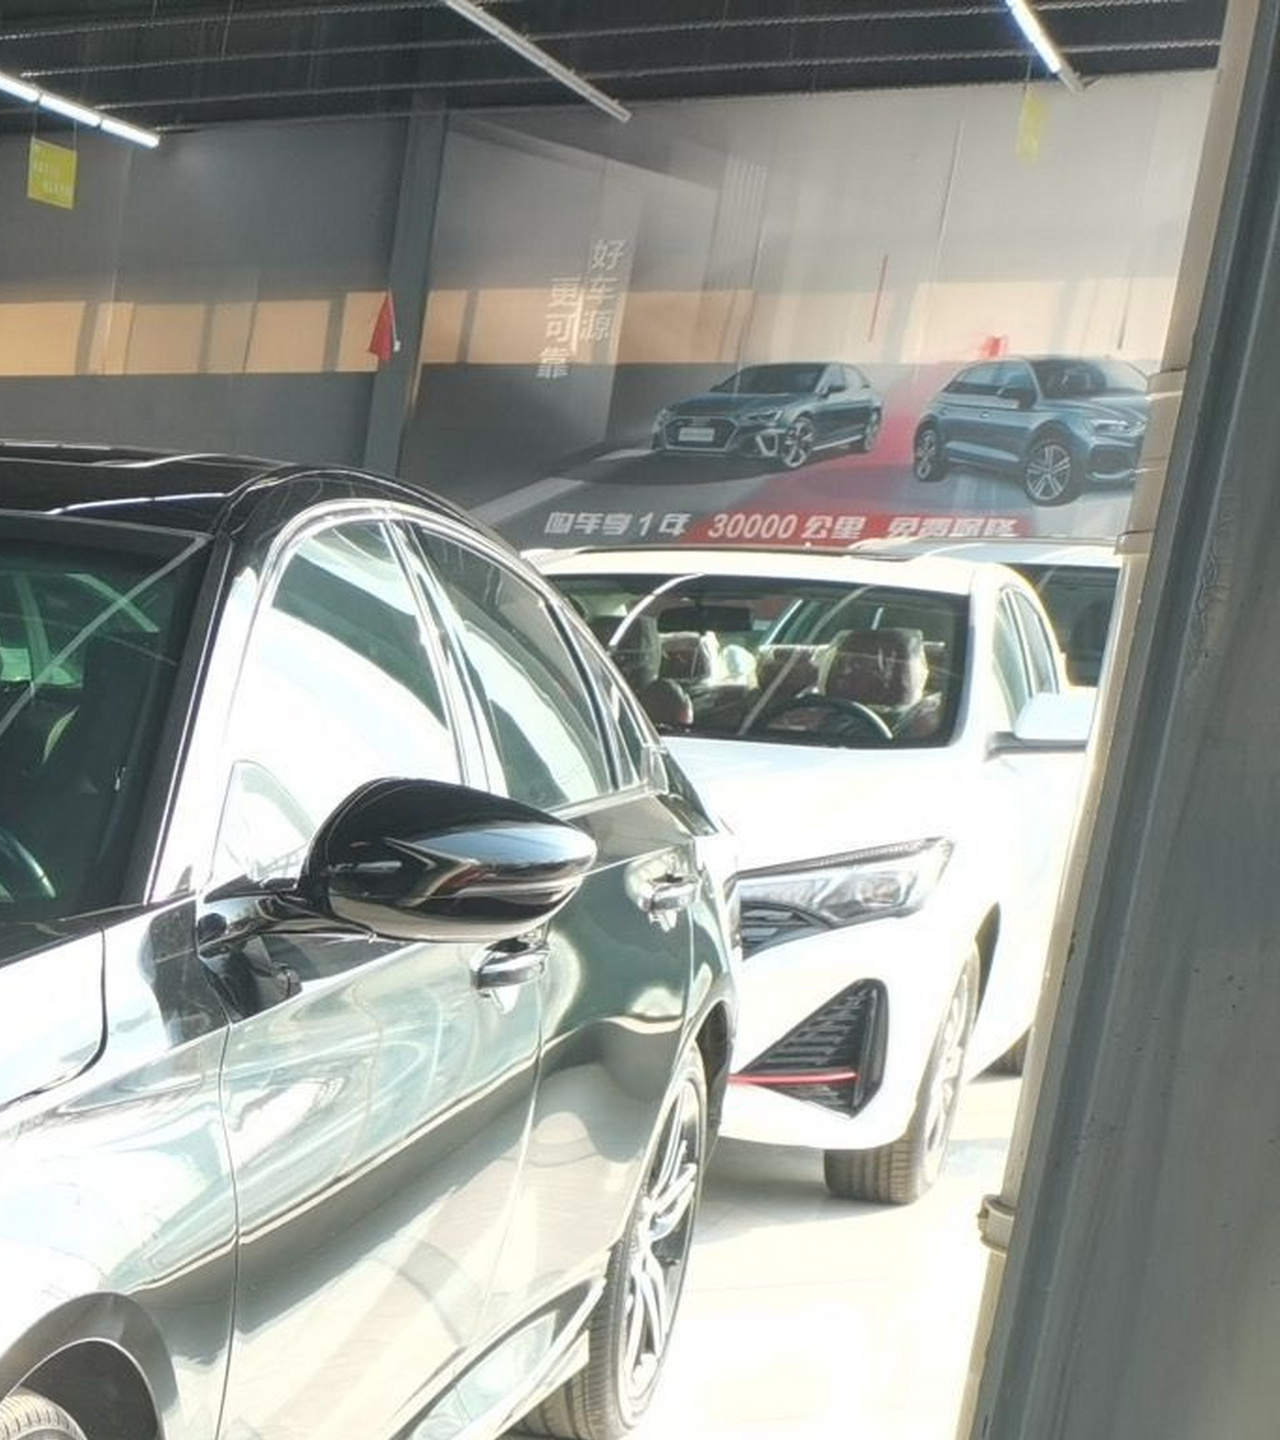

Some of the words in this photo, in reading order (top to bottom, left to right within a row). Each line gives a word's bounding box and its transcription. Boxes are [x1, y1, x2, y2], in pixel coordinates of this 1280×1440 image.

[535, 276, 581, 379] 更可靠
[579, 238, 627, 342] 好车源
